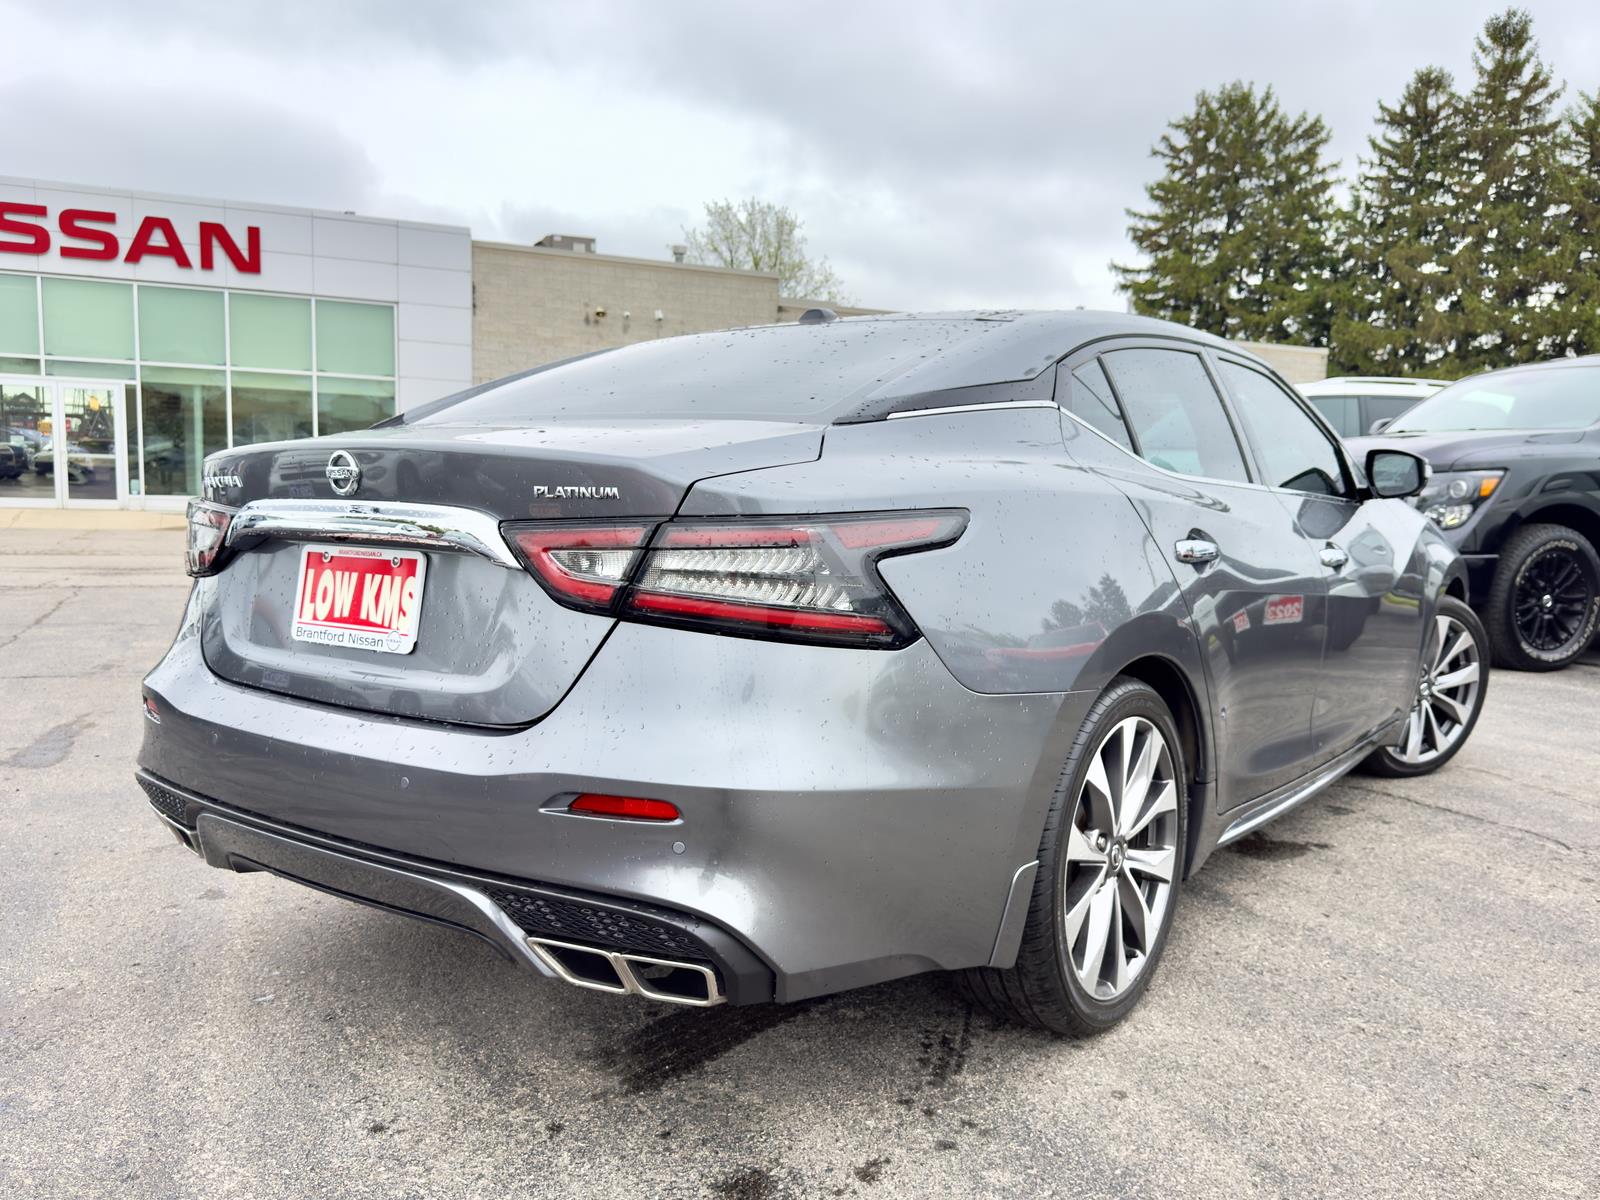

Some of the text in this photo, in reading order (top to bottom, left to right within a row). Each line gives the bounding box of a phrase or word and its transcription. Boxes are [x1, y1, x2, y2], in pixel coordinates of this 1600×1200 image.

[0, 201, 262, 275] SSAN
[533, 485, 620, 500] PLATINUM
[300, 568, 417, 636] LOW KMS
[296, 626, 384, 647] Brantford Nissan
